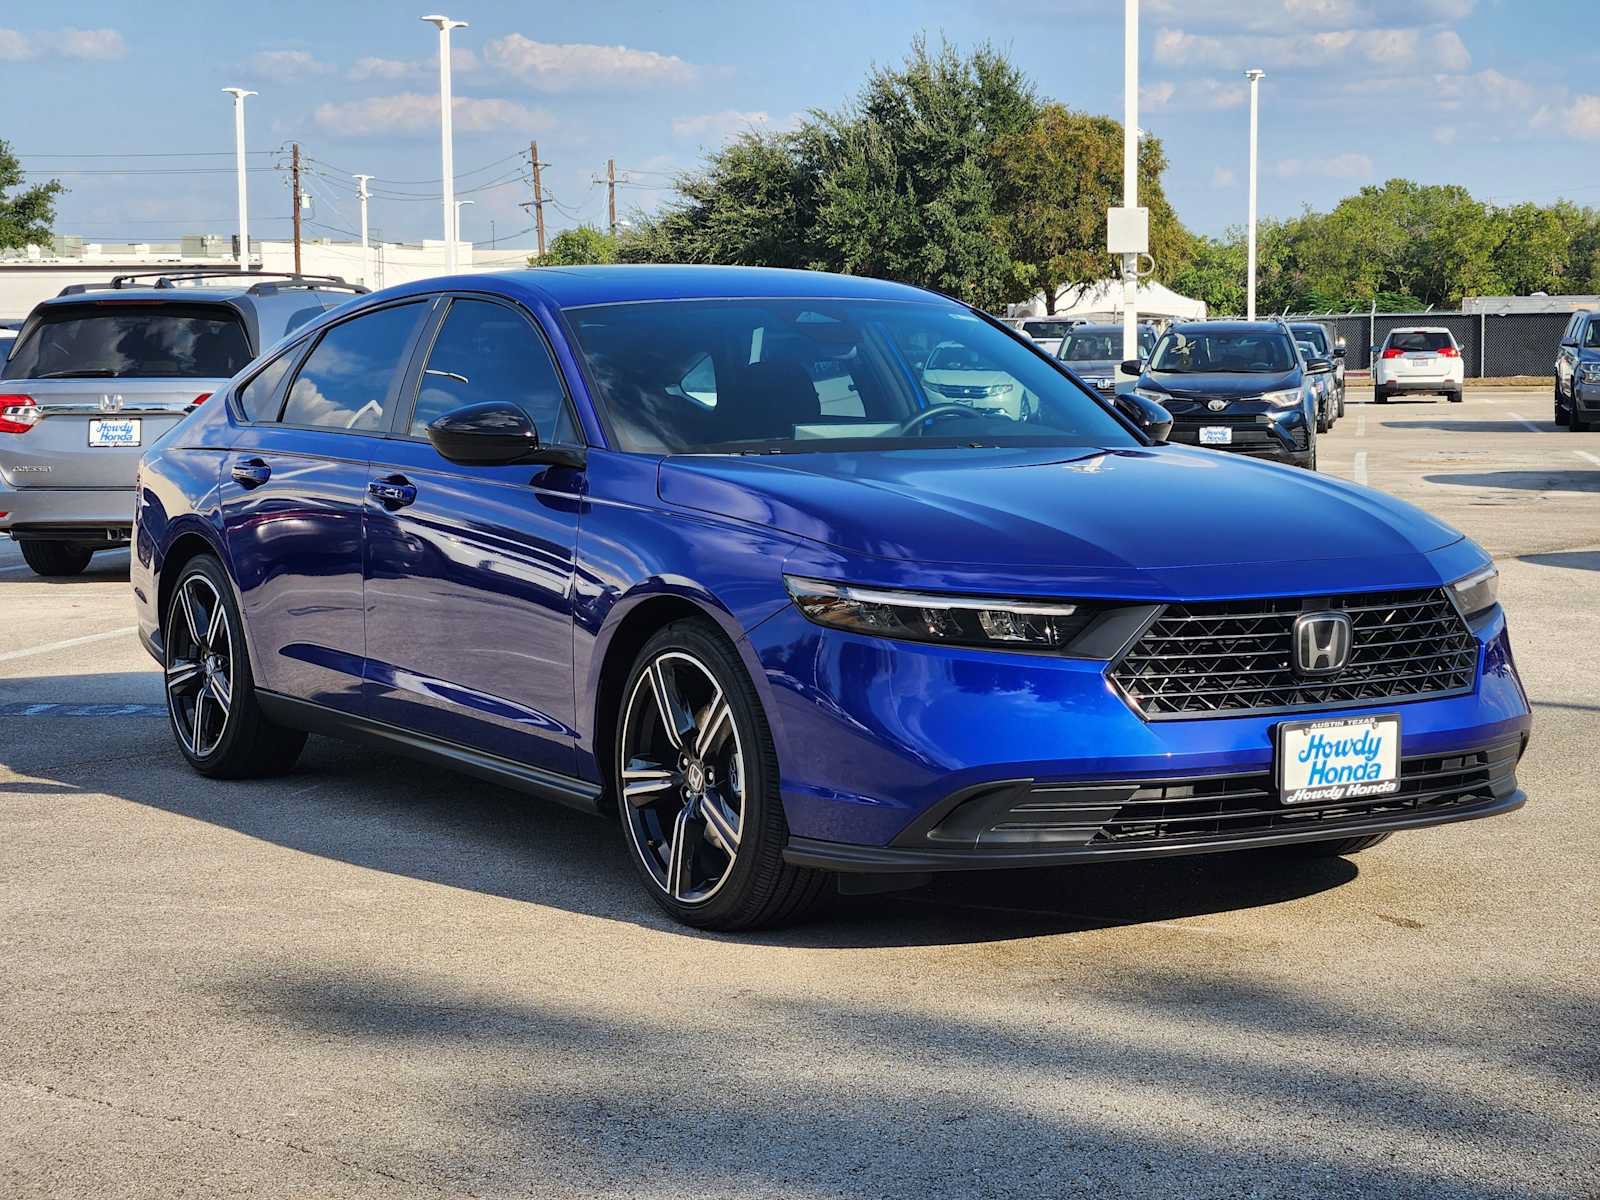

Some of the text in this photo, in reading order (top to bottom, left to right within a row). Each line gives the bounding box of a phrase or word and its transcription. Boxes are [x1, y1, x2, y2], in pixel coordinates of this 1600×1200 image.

[96, 423, 133, 433] Howdy
[100, 431, 133, 441] Honda
[1311, 717, 1376, 729] AUSTIN TEXAS
[1298, 729, 1383, 763] Howdy
[1307, 760, 1382, 786] Honda
[1286, 781, 1397, 802] Howdy Honda
